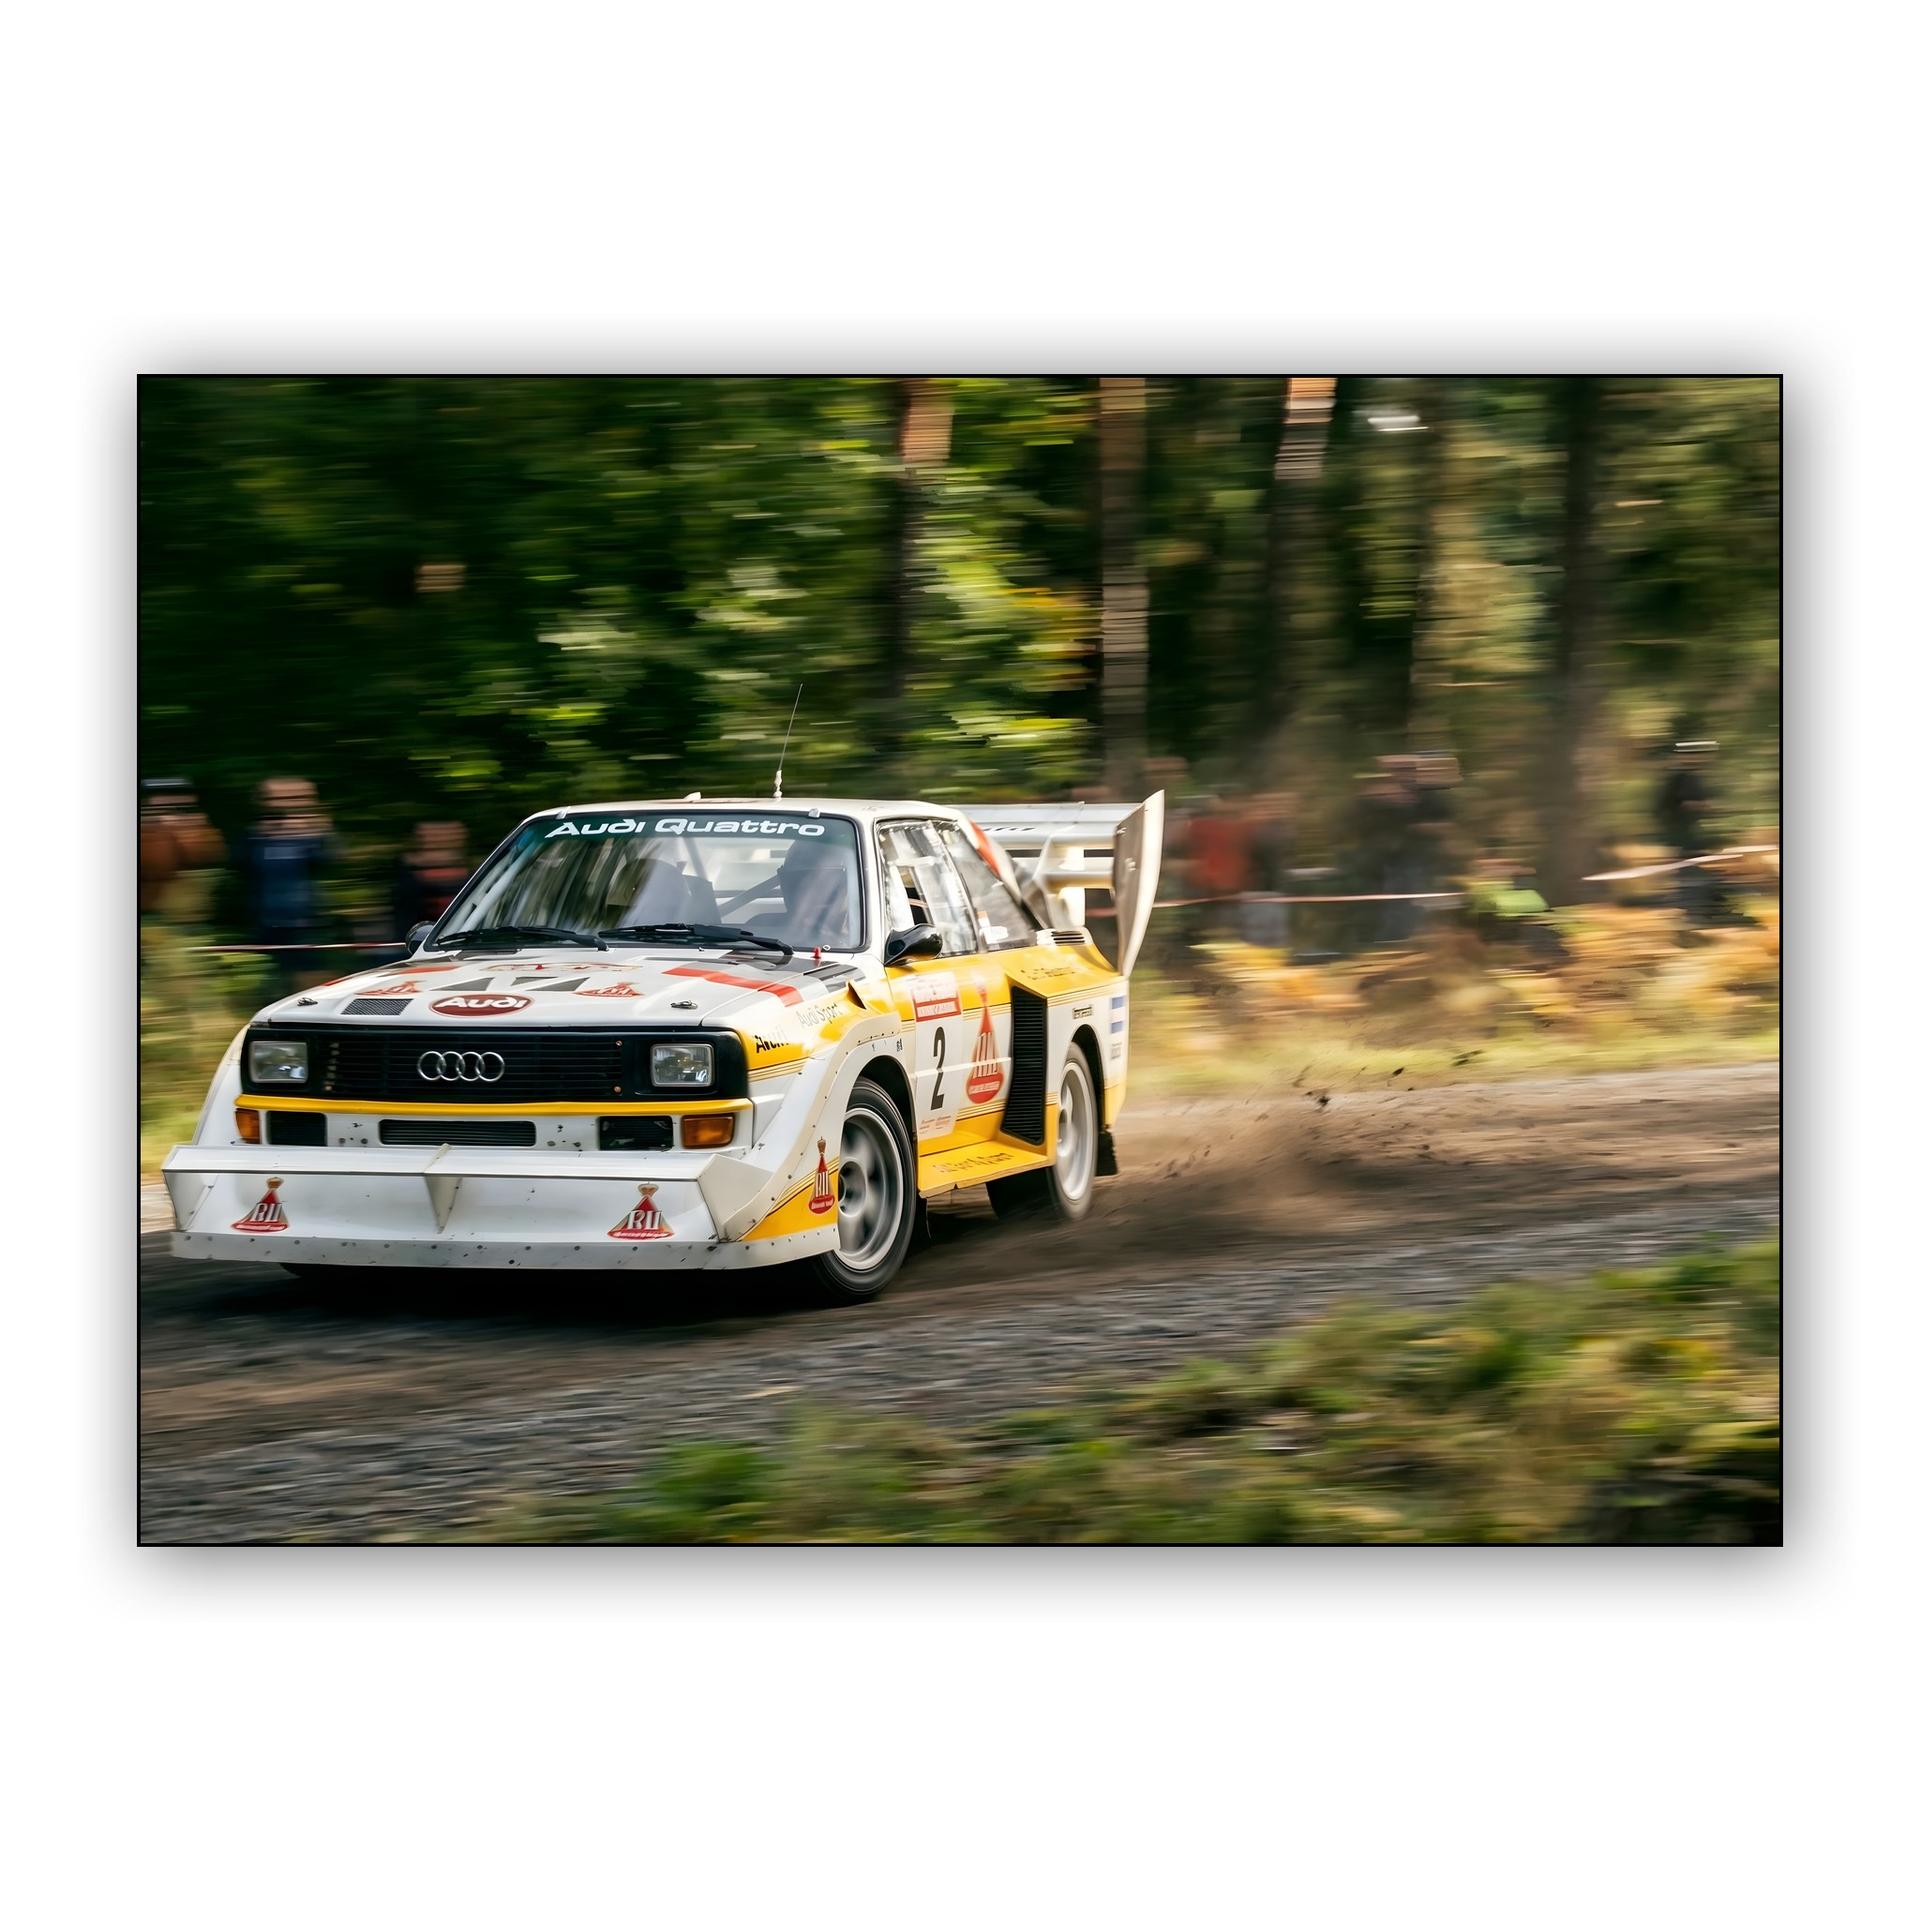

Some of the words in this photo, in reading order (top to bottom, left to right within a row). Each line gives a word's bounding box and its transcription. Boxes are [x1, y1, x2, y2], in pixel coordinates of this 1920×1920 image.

[545, 818, 646, 839] Audi
[654, 818, 826, 837] Quattro
[439, 996, 527, 1011] Audi
[930, 1026, 946, 1111] 2
